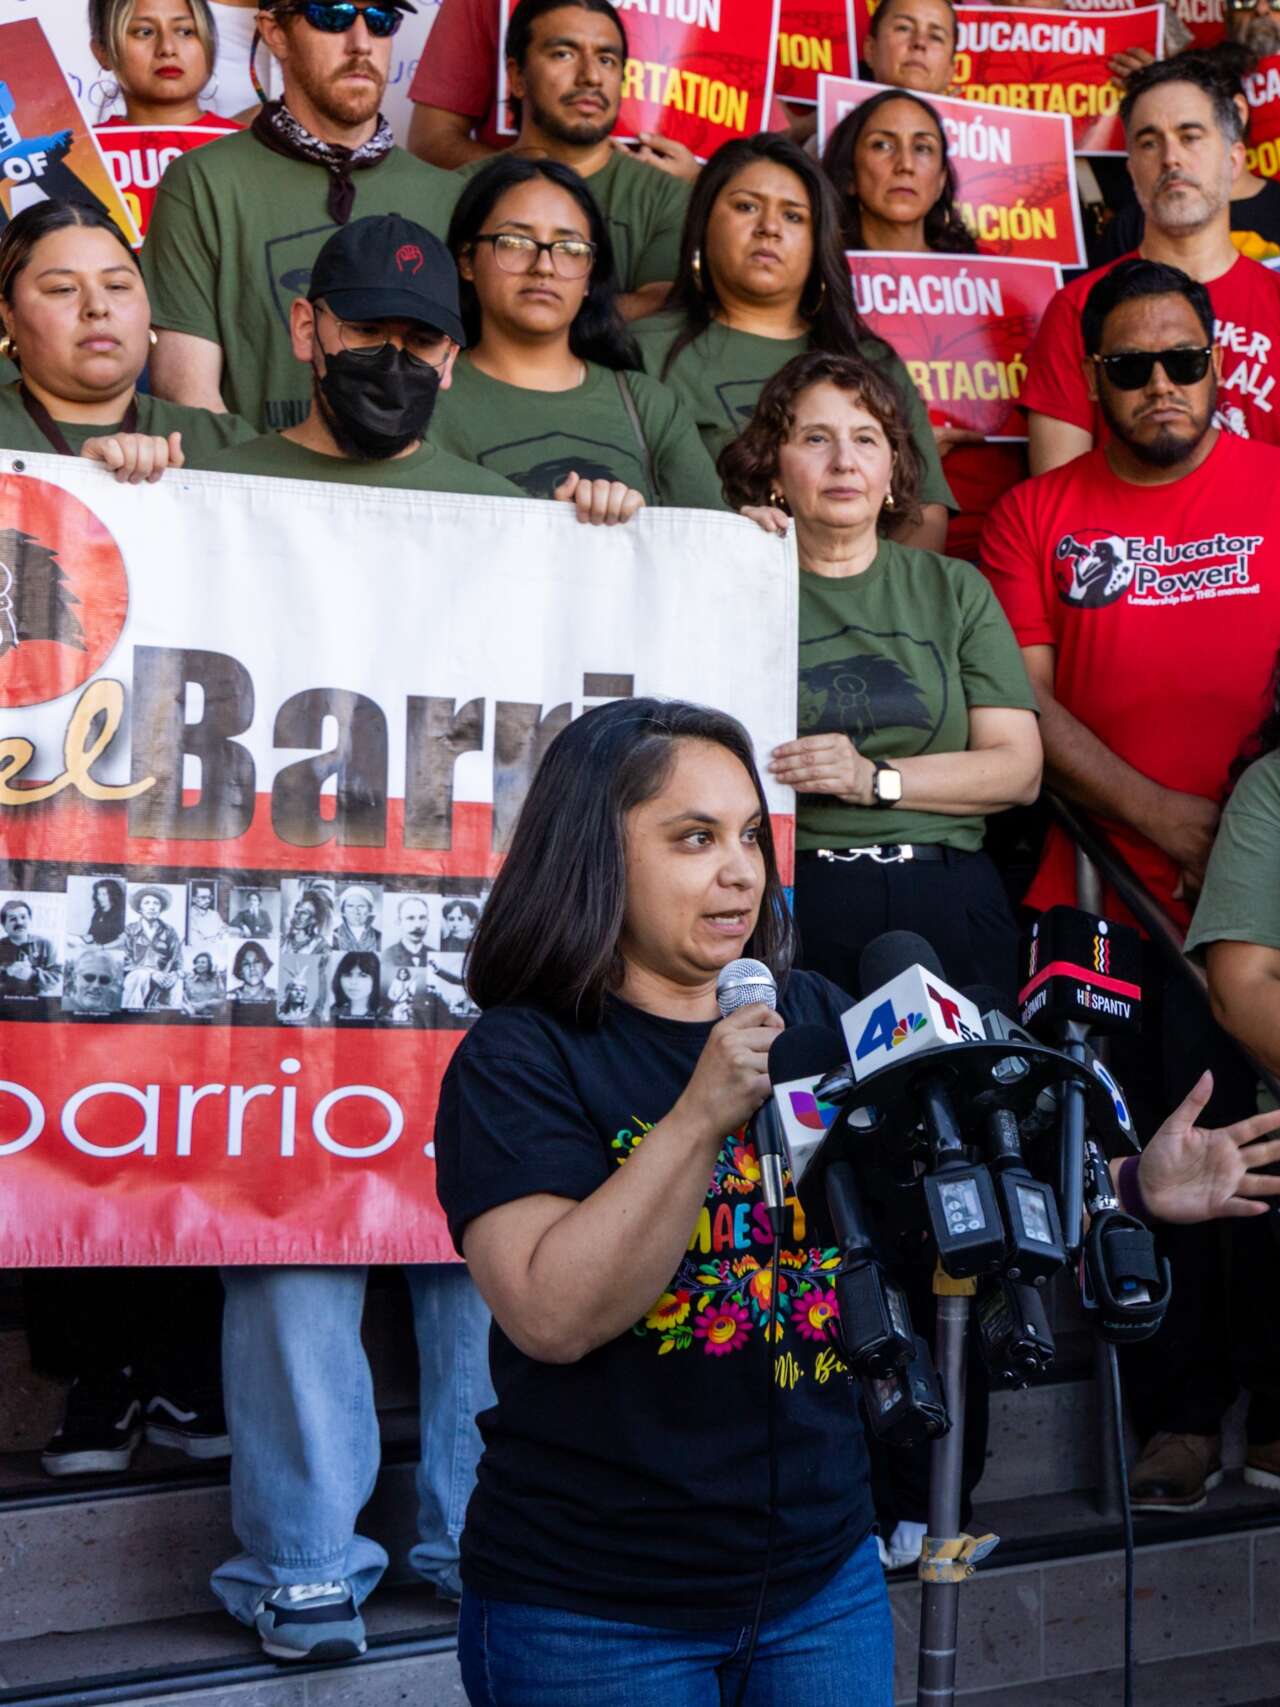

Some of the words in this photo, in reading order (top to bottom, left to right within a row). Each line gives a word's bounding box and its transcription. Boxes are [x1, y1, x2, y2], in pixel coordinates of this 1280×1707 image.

[3, 151, 48, 181] OF
[1125, 533, 1263, 565] Educator
[1135, 555, 1249, 596] Power!
[127, 645, 634, 852] Barr
[856, 998, 898, 1061] 4
